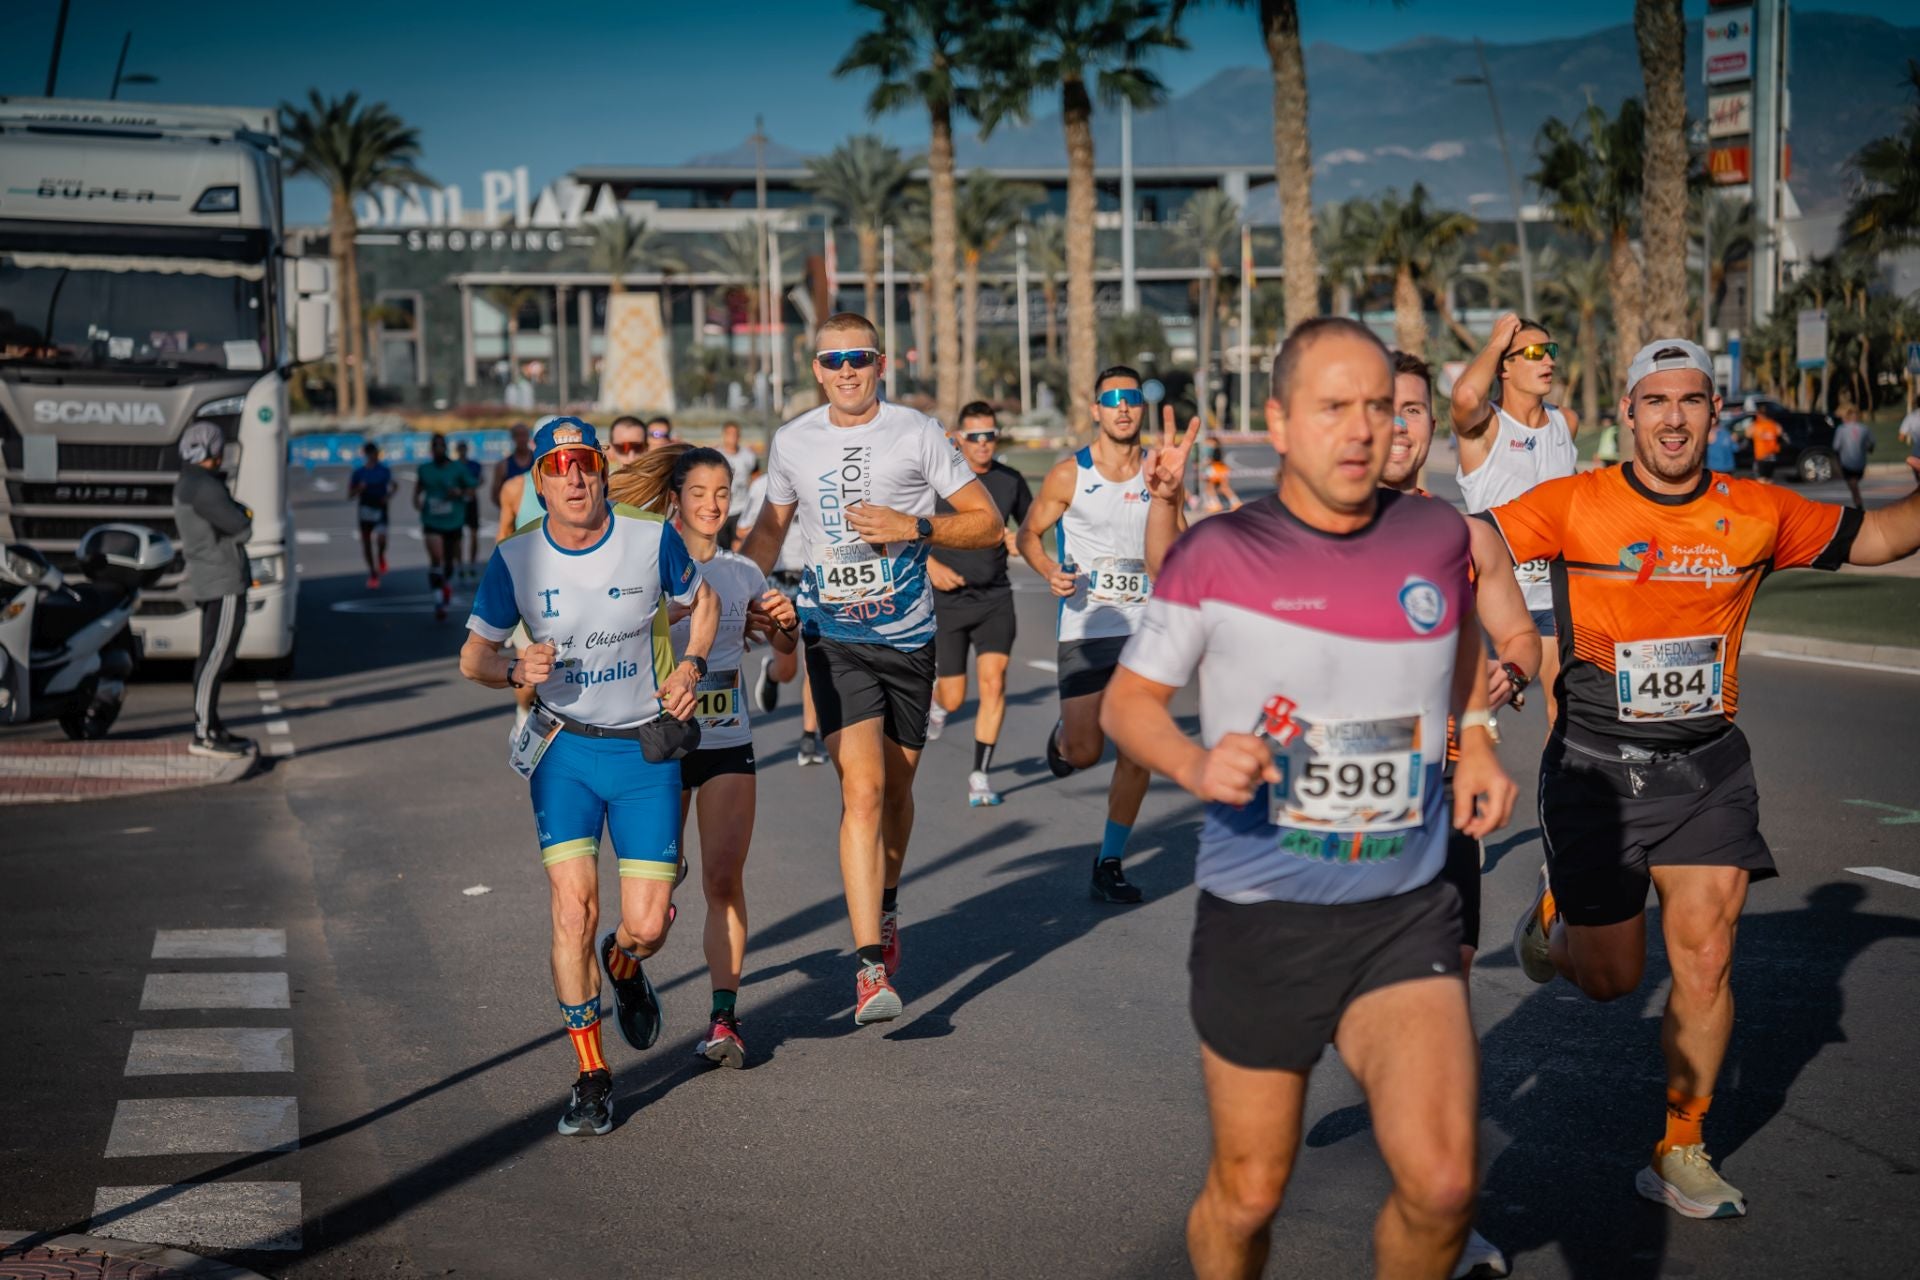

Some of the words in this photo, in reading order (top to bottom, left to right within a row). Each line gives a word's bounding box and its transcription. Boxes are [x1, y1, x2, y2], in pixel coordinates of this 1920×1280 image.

[406, 230, 564, 251] SHOPPING
[33, 400, 166, 425] SCANIA
[56, 485, 149, 500] SUPER
[818, 469, 843, 545] MEDIA
[827, 563, 876, 588] 485
[1101, 573, 1140, 592] 336
[843, 596, 896, 620] KIDS
[585, 628, 642, 650] Chipiona
[1653, 641, 1694, 657] MEDIA
[565, 659, 638, 688] aqualia
[1637, 669, 1706, 699] 484
[1301, 761, 1397, 799] 598
